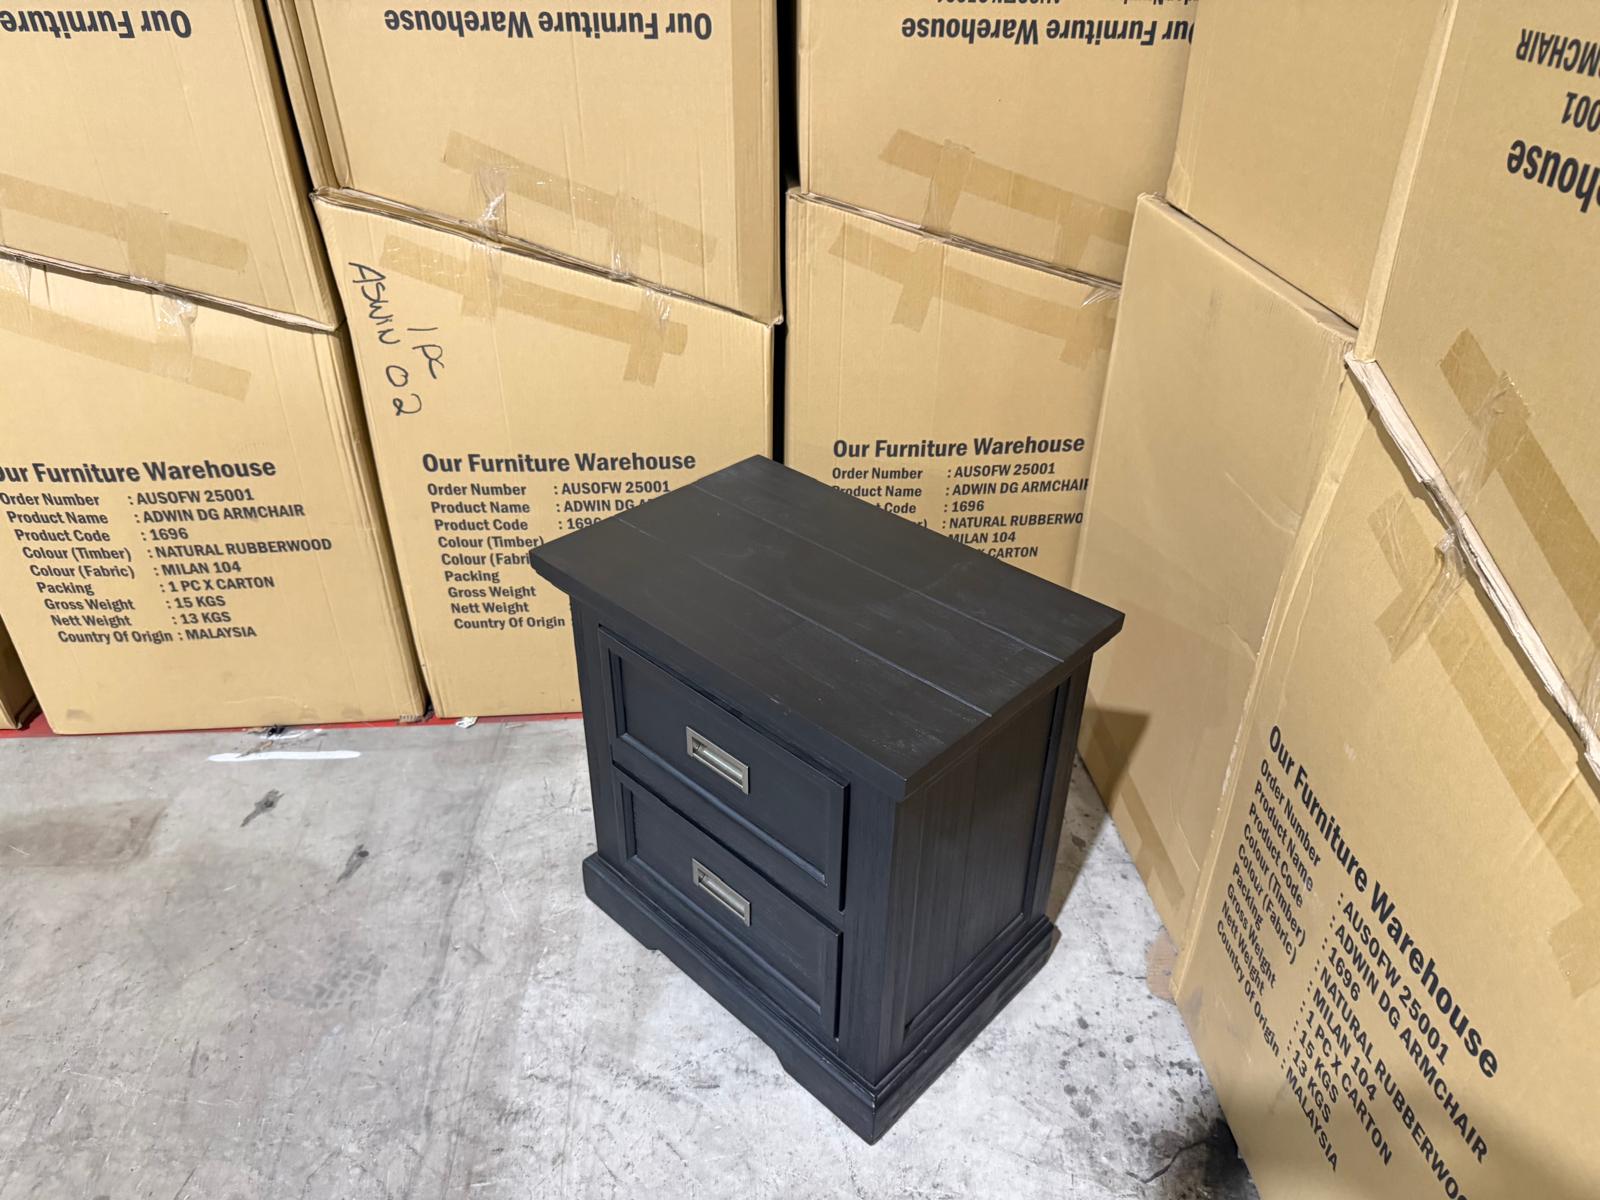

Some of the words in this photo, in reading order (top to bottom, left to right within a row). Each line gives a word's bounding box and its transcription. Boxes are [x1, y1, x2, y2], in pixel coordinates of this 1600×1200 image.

[0, 10, 136, 39] Furniture
[140, 10, 192, 38] Our
[384, 10, 534, 38] Warehouse
[538, 11, 658, 40] Furniture
[665, 12, 712, 40] Our
[902, 18, 1038, 45] Warehouse
[1046, 19, 1158, 46] Furniture
[1516, 28, 1600, 78] MCHAIR
[1506, 138, 1600, 214] house
[833, 440, 870, 458] Our
[875, 440, 968, 458] Furniture
[974, 436, 1085, 456] Warehouse
[32, 463, 140, 483] Furniture
[142, 460, 276, 481] Warehouse
[422, 453, 462, 472] Our
[468, 454, 570, 472] Furniture
[574, 452, 696, 472] Warehouse
[832, 467, 869, 479] Order
[872, 467, 923, 479] Number
[954, 464, 1011, 478] AUSOFW
[1013, 462, 1055, 476] 25001
[0, 492, 40, 506] Order
[41, 493, 99, 506] Number
[137, 490, 200, 505] AUSOFW
[204, 488, 254, 502] 25001
[427, 483, 468, 496] Order
[470, 483, 527, 496] Number
[562, 482, 622, 495] AUSOFW
[626, 480, 670, 494] 25001
[885, 485, 922, 497] Name
[952, 482, 997, 496] ADWIN
[1000, 482, 1018, 494] DG
[6, 510, 65, 524] Product
[65, 512, 108, 524] Name
[144, 509, 194, 523] ADWIN
[196, 508, 220, 521] DG
[224, 504, 305, 520] ARMCHAIR
[430, 501, 487, 514] Product
[490, 501, 530, 513] Name
[564, 500, 611, 512] ADWIN
[614, 499, 635, 512] DG
[884, 502, 917, 514] Code
[952, 500, 984, 512] 1696
[434, 519, 490, 531] Product
[492, 518, 528, 531] Code
[949, 516, 1007, 529] NATURAL
[14, 529, 72, 542] Product
[73, 529, 110, 542] Code
[150, 527, 189, 541] 1696
[438, 536, 484, 548] Colour
[486, 536, 544, 550] (Timber)
[992, 531, 1016, 543] 104
[22, 546, 68, 559] Colour
[71, 547, 132, 562] (Timber)
[154, 544, 224, 558] NATURAL
[225, 538, 332, 555] RUBBERWOOD
[441, 553, 486, 566] Colour
[988, 546, 1038, 559] CARTON
[30, 564, 75, 577] Colour
[78, 565, 135, 579] (Fabric)
[161, 562, 210, 576] MILAN
[213, 560, 242, 574] 104
[444, 570, 500, 584] Packing
[36, 582, 95, 596] Packing
[168, 581, 179, 592] 1
[180, 580, 201, 592] PC
[202, 579, 214, 590] X
[216, 576, 275, 590] CARTON
[448, 586, 487, 598] Gross
[488, 586, 536, 600] Weight
[44, 598, 84, 610] Gross
[84, 598, 136, 613] Weight
[174, 596, 193, 609] 15
[195, 595, 226, 608] KGS
[450, 603, 480, 614] Nett
[482, 602, 530, 615] Weight
[50, 614, 82, 626] Nett
[81, 615, 132, 629] Weight
[180, 613, 199, 624] 13
[201, 611, 232, 623] KGS
[454, 618, 506, 630] Country
[508, 616, 523, 628] Of
[526, 616, 566, 629] Origin
[58, 630, 110, 645] Country
[113, 630, 129, 642] Of
[131, 630, 174, 645] Origin
[185, 626, 257, 640] MALAYSIA
[1249, 802, 1281, 867] Product
[1280, 860, 1303, 908] Code
[1328, 947, 1360, 1002] 1696
[1270, 725, 1295, 775] Our
[1294, 764, 1368, 892] Furniture
[1371, 880, 1498, 1078] Warehouse
[1261, 759, 1285, 805] Order
[1284, 798, 1321, 866] Number
[1342, 901, 1402, 988] AUSOFW
[1398, 985, 1448, 1066] 25001
[1238, 844, 1264, 896] Colour
[1262, 893, 1296, 965] (Fabric)
[1312, 987, 1352, 1058] MILAN
[1350, 1056, 1377, 1102] 104
[1254, 780, 1287, 846] Product
[1286, 837, 1313, 892] Name
[1334, 924, 1379, 995] ADWIN
[1378, 990, 1400, 1030] DG
[1399, 1028, 1488, 1164] ARMCHAIR
[1227, 883, 1248, 930] Gross
[1248, 924, 1276, 989] Weight
[1299, 1030, 1315, 1059] 15
[1314, 1056, 1339, 1104] KGS
[1222, 900, 1238, 939] Nett
[1238, 932, 1264, 996] Weight
[1292, 1050, 1308, 1078] 13
[1307, 1076, 1331, 1124] KGS
[1232, 862, 1264, 931] Packing
[1306, 1010, 1314, 1029] 1
[1314, 1024, 1332, 1058] PC
[1330, 1054, 1342, 1076] X
[1342, 1073, 1392, 1166] CARTON
[1244, 824, 1270, 876] Colour
[1268, 872, 1306, 947] (Timber)
[1320, 966, 1373, 1064] NATURAL
[1374, 1059, 1466, 1200] RUBBERWO
[1217, 920, 1245, 983] Country
[1244, 980, 1256, 1003] Of
[1254, 1000, 1279, 1057] Origin
[1286, 1066, 1338, 1172] MALAYSIA
